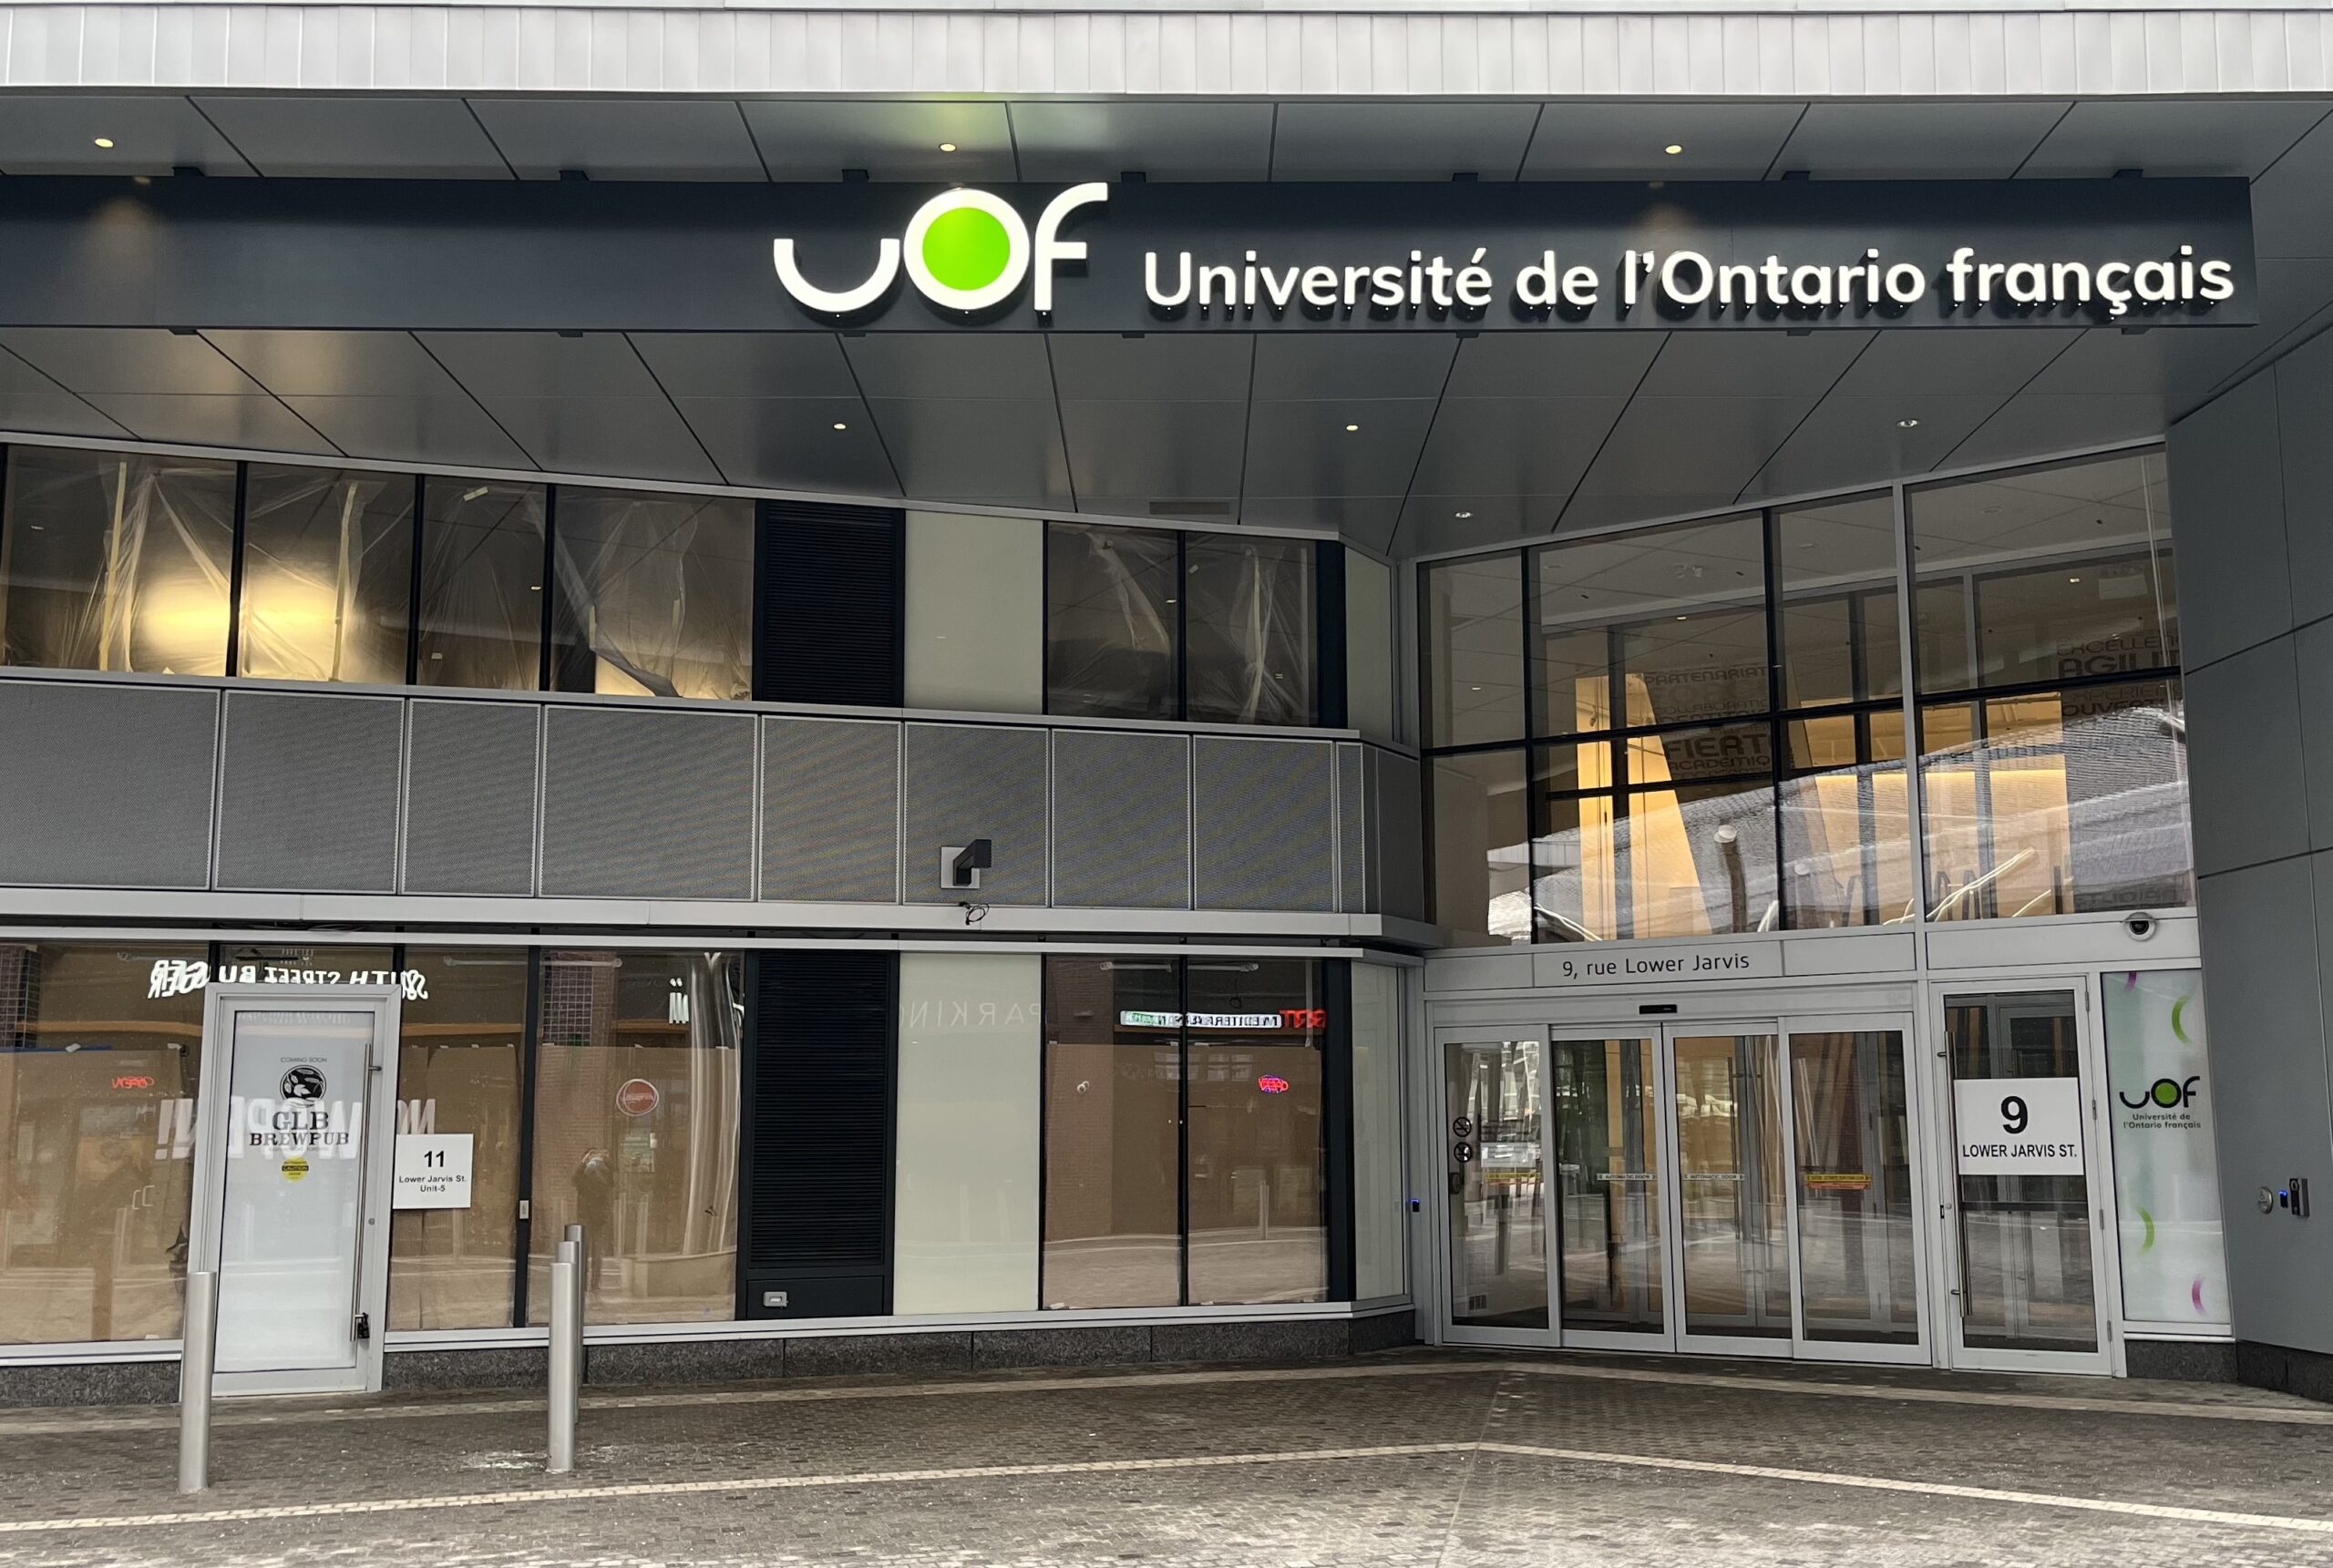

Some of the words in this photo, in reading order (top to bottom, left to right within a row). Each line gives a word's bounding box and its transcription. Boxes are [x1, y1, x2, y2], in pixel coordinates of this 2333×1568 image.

[1146, 248, 1493, 307] Université
[1516, 251, 1598, 305] de
[1948, 245, 2235, 315] français
[2057, 635, 2179, 655] EXCELLEN
[1667, 733, 1772, 759] FIERT
[1562, 960, 1578, 979] 9,
[1587, 962, 1617, 976] rue
[1626, 958, 1684, 974] Lower
[1692, 953, 1750, 971] Jarvis
[272, 1111, 329, 1131] GLB
[2000, 1096, 2028, 1134] 9
[2132, 1112, 2177, 1121] Université
[2179, 1112, 2190, 1121] de
[2164, 1121, 2201, 1130] français
[249, 1132, 349, 1146] BREWPUB
[424, 1150, 445, 1168] 11
[1962, 1144, 2007, 1157] LOWER
[2011, 1144, 2055, 1157] JARVIS
[2059, 1144, 2077, 1157] ST.
[398, 1175, 426, 1184] Lower
[427, 1174, 453, 1183] Jarvis
[456, 1174, 467, 1183] St.
[419, 1184, 446, 1193] Unit-5
